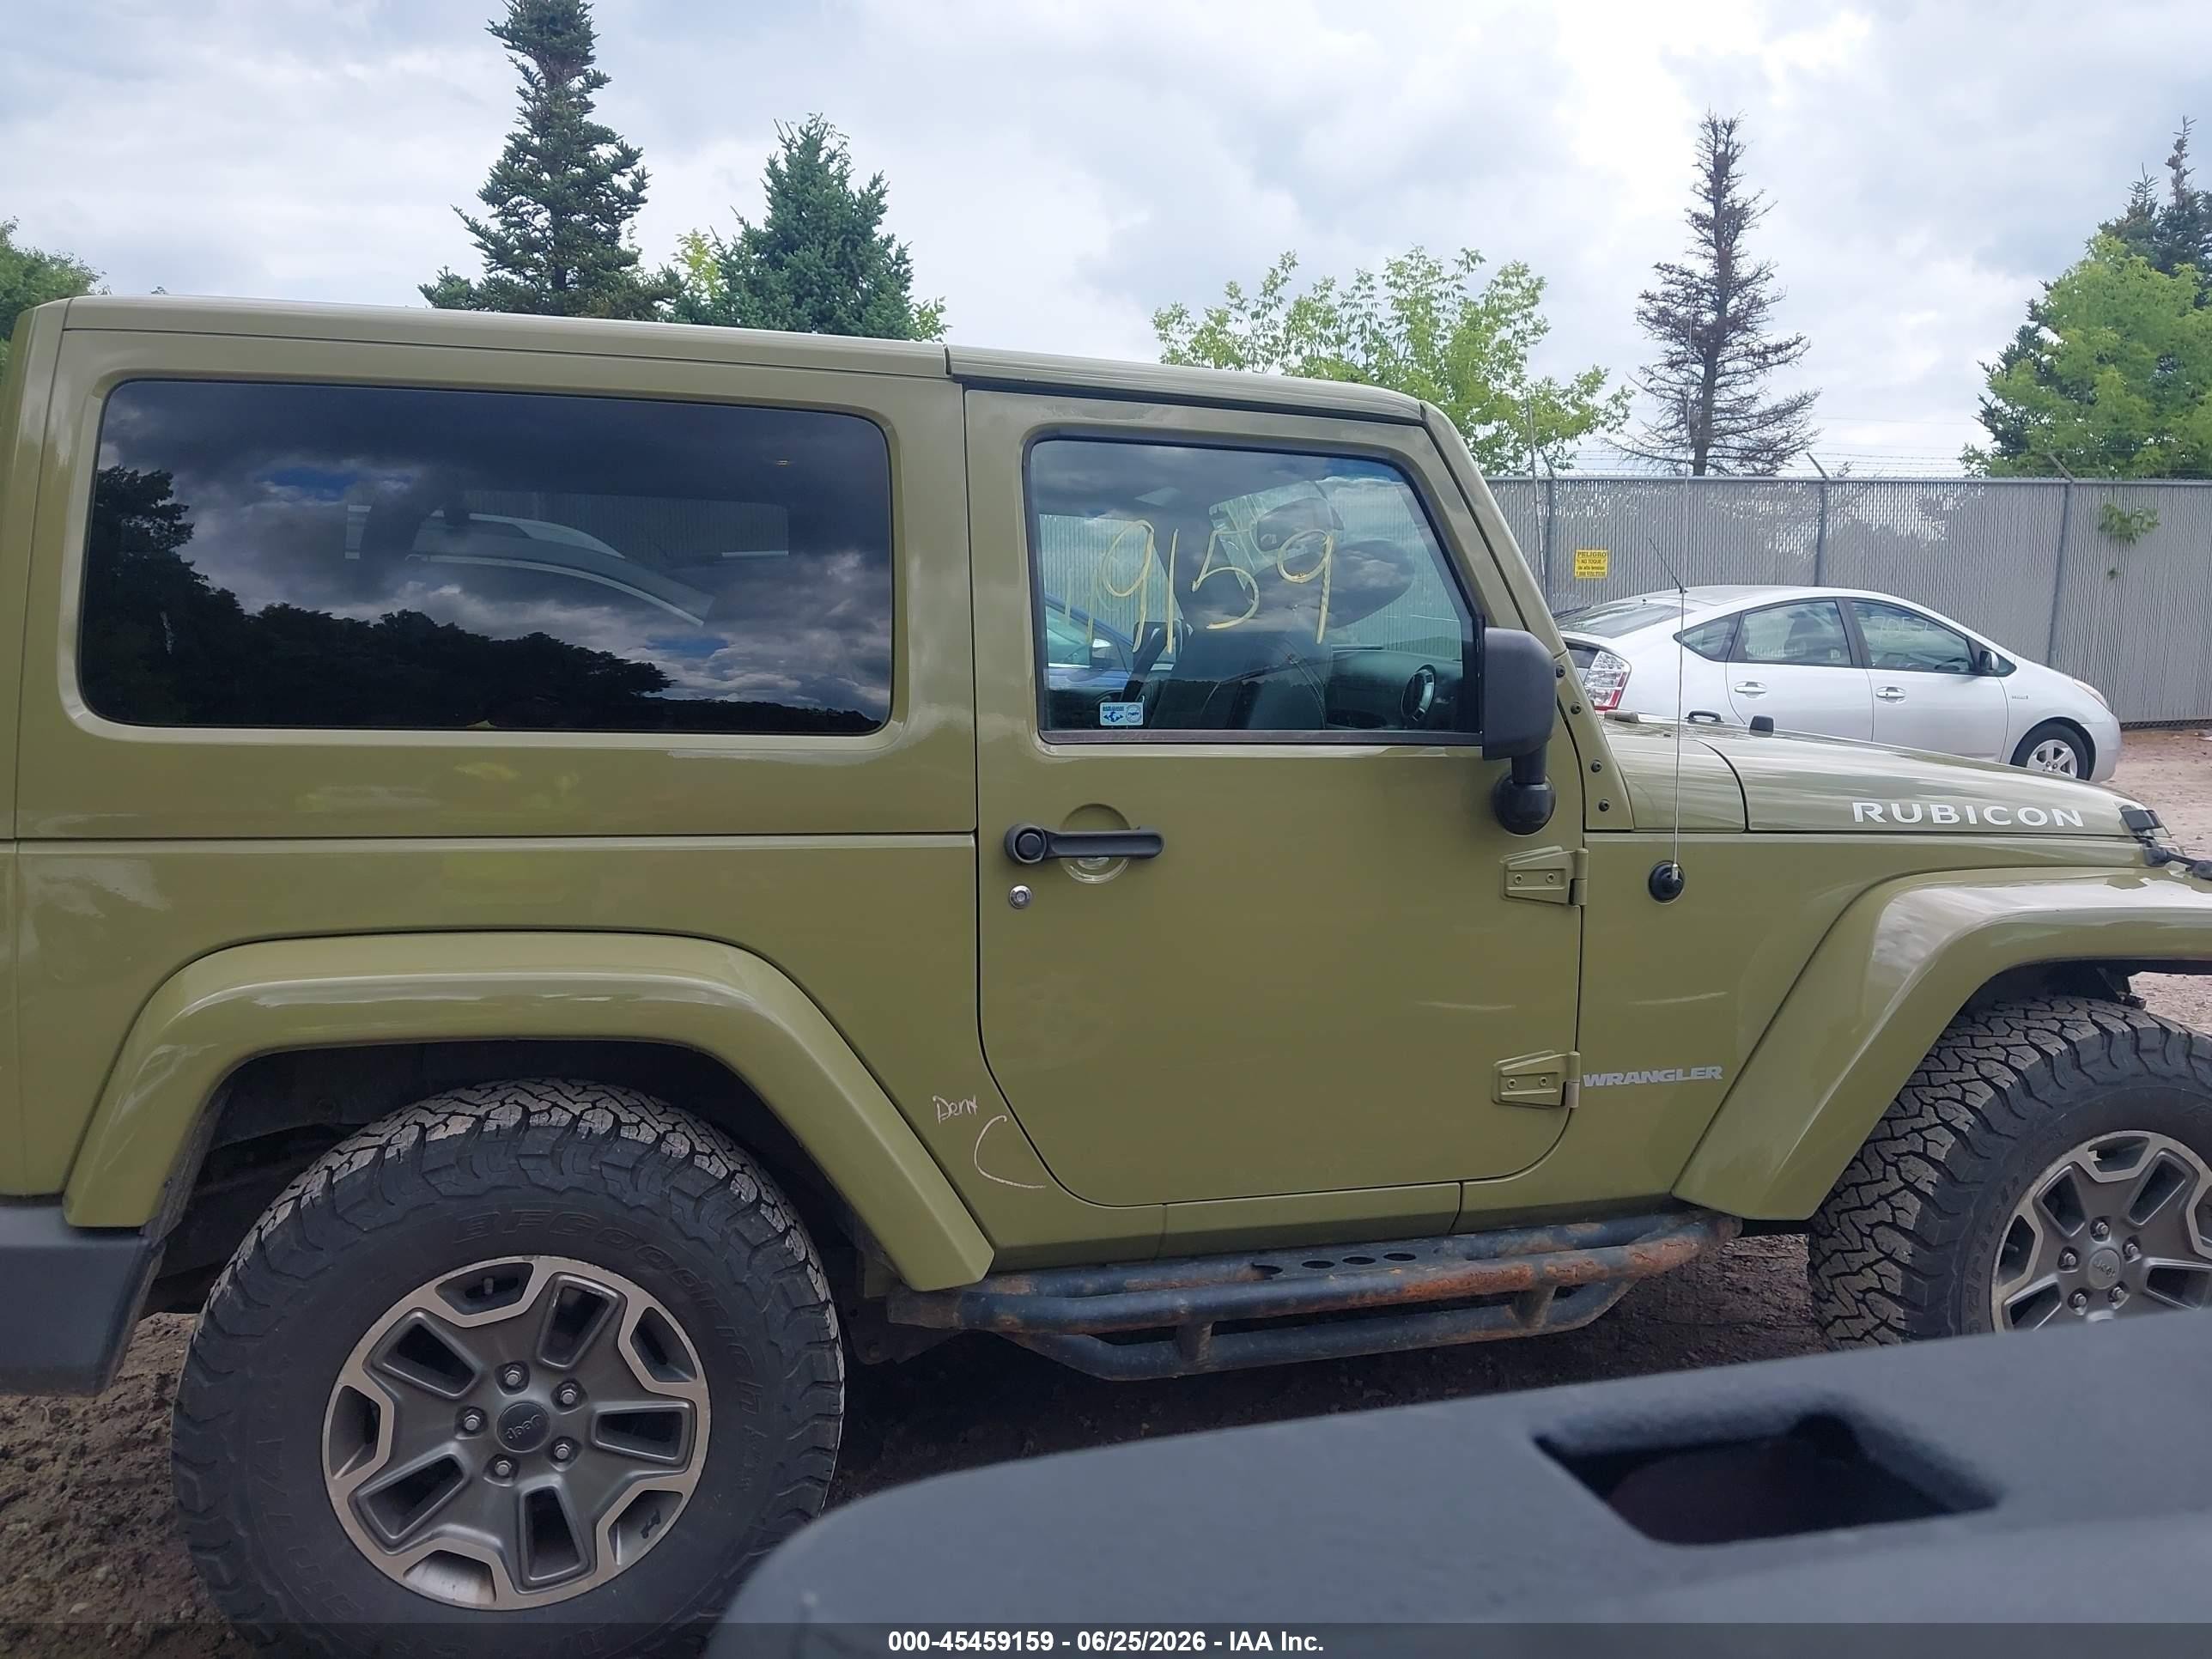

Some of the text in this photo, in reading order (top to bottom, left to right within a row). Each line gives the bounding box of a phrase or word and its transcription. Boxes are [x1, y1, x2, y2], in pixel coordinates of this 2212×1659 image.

[1101, 520, 1333, 654] 9159
[1851, 801, 2085, 828] RUBICON
[1583, 1065, 1724, 1087] WRANGLER
[453, 1208, 764, 1415] BFGoodrich
[505, 1413, 543, 1440] Jeep
